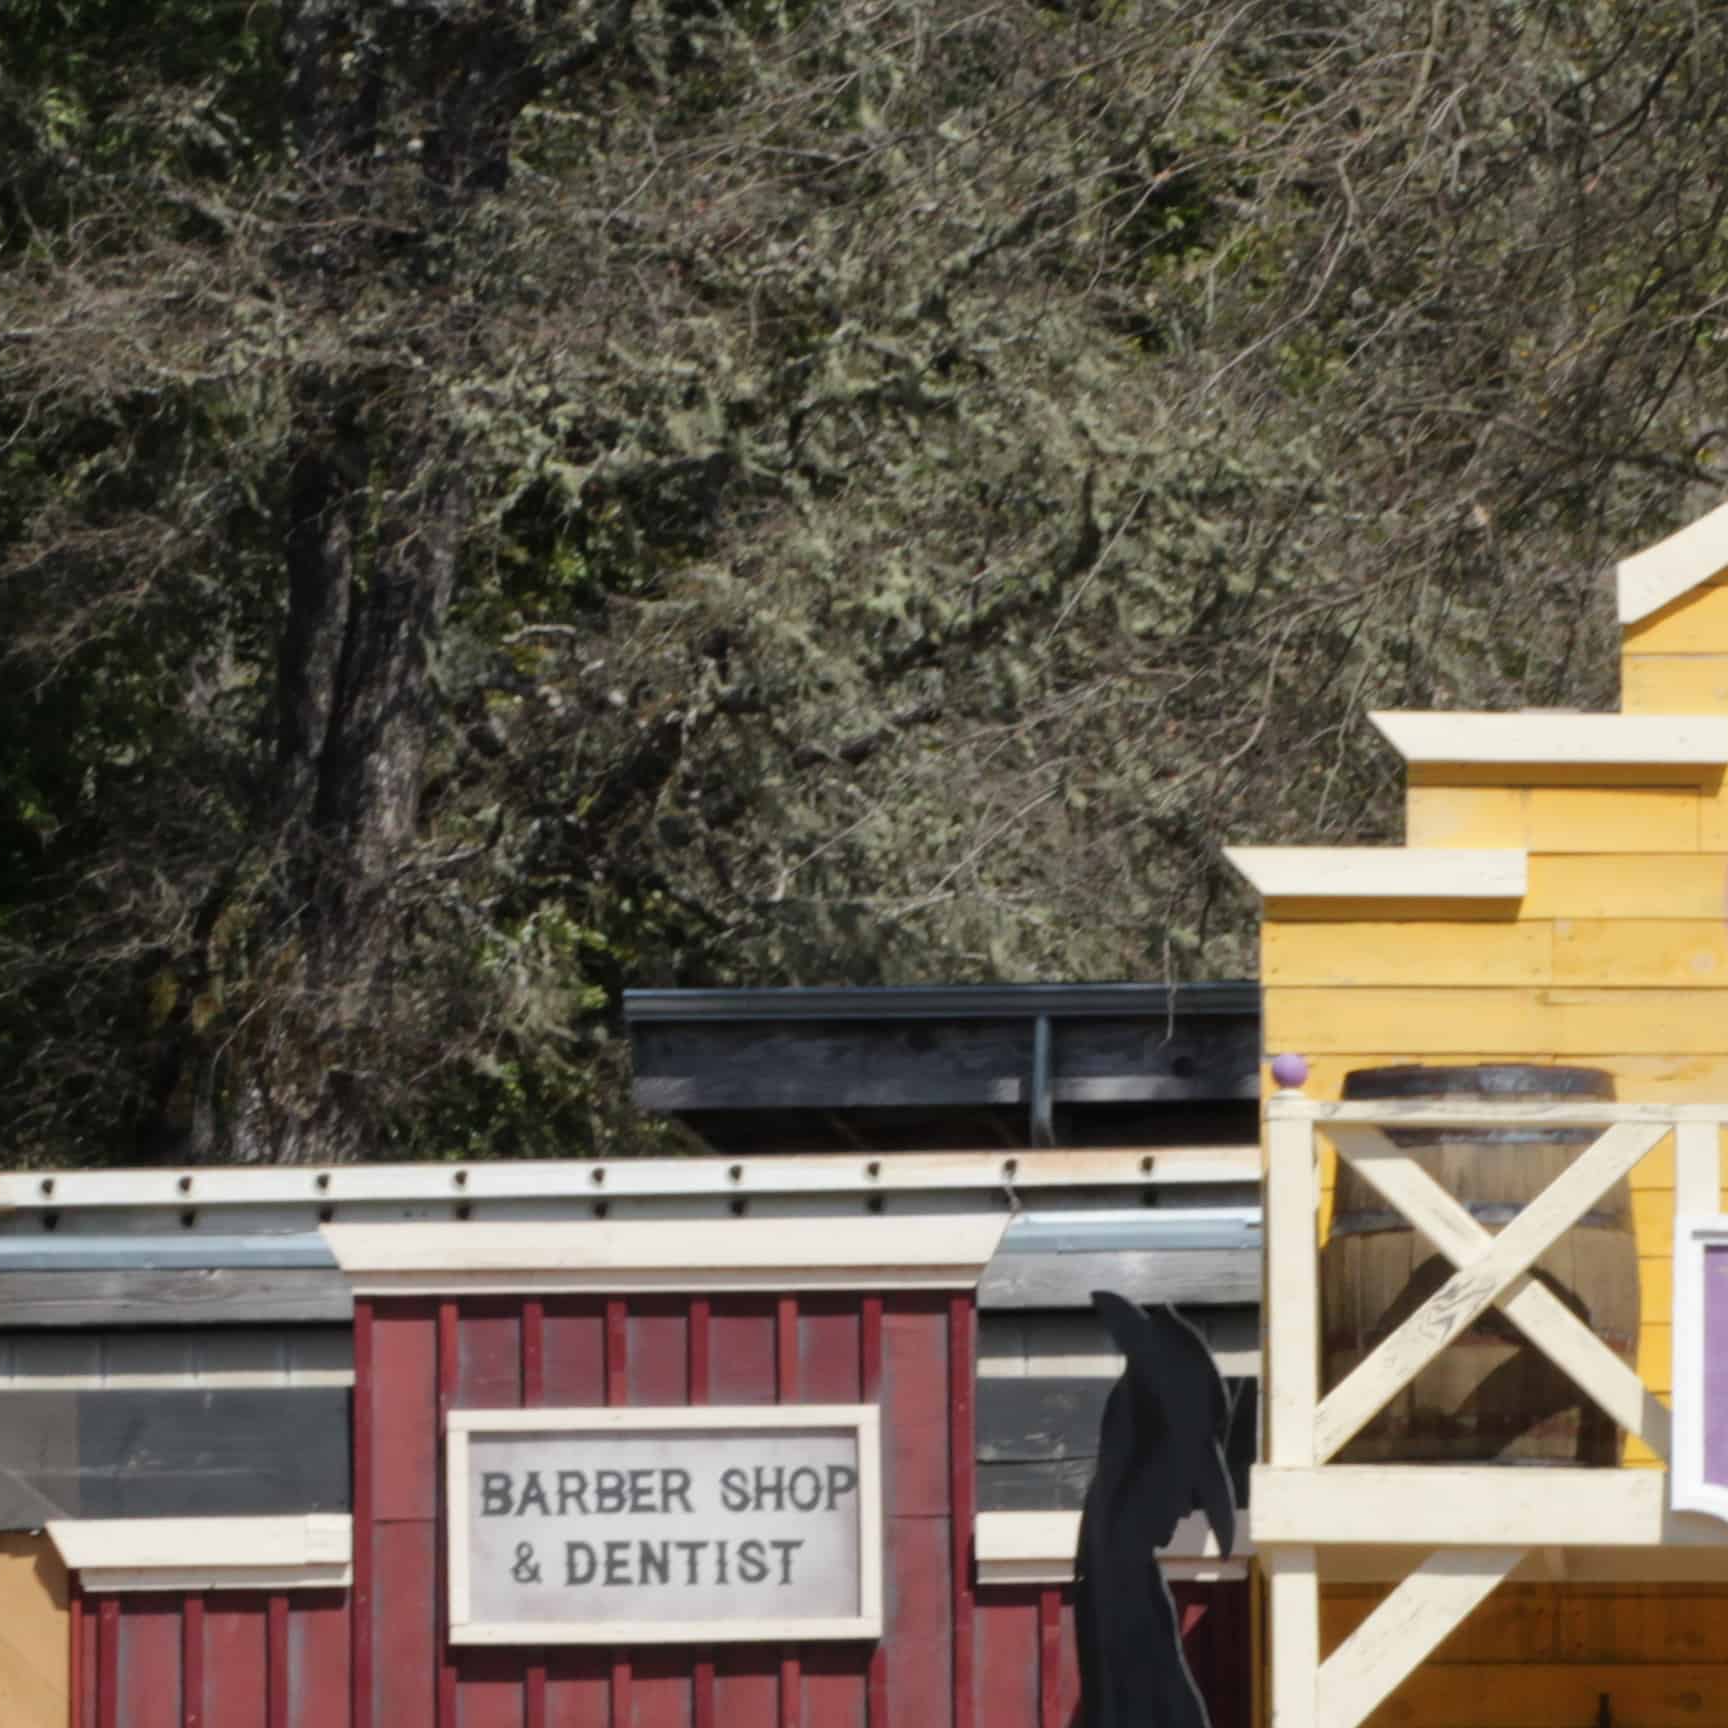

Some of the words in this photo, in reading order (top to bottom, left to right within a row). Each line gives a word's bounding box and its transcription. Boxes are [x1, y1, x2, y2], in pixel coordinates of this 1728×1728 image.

[481, 1469, 693, 1516] BARBER
[719, 1465, 859, 1512] SHOP
[508, 1540, 543, 1584] &
[564, 1538, 805, 1587] DENTIST
